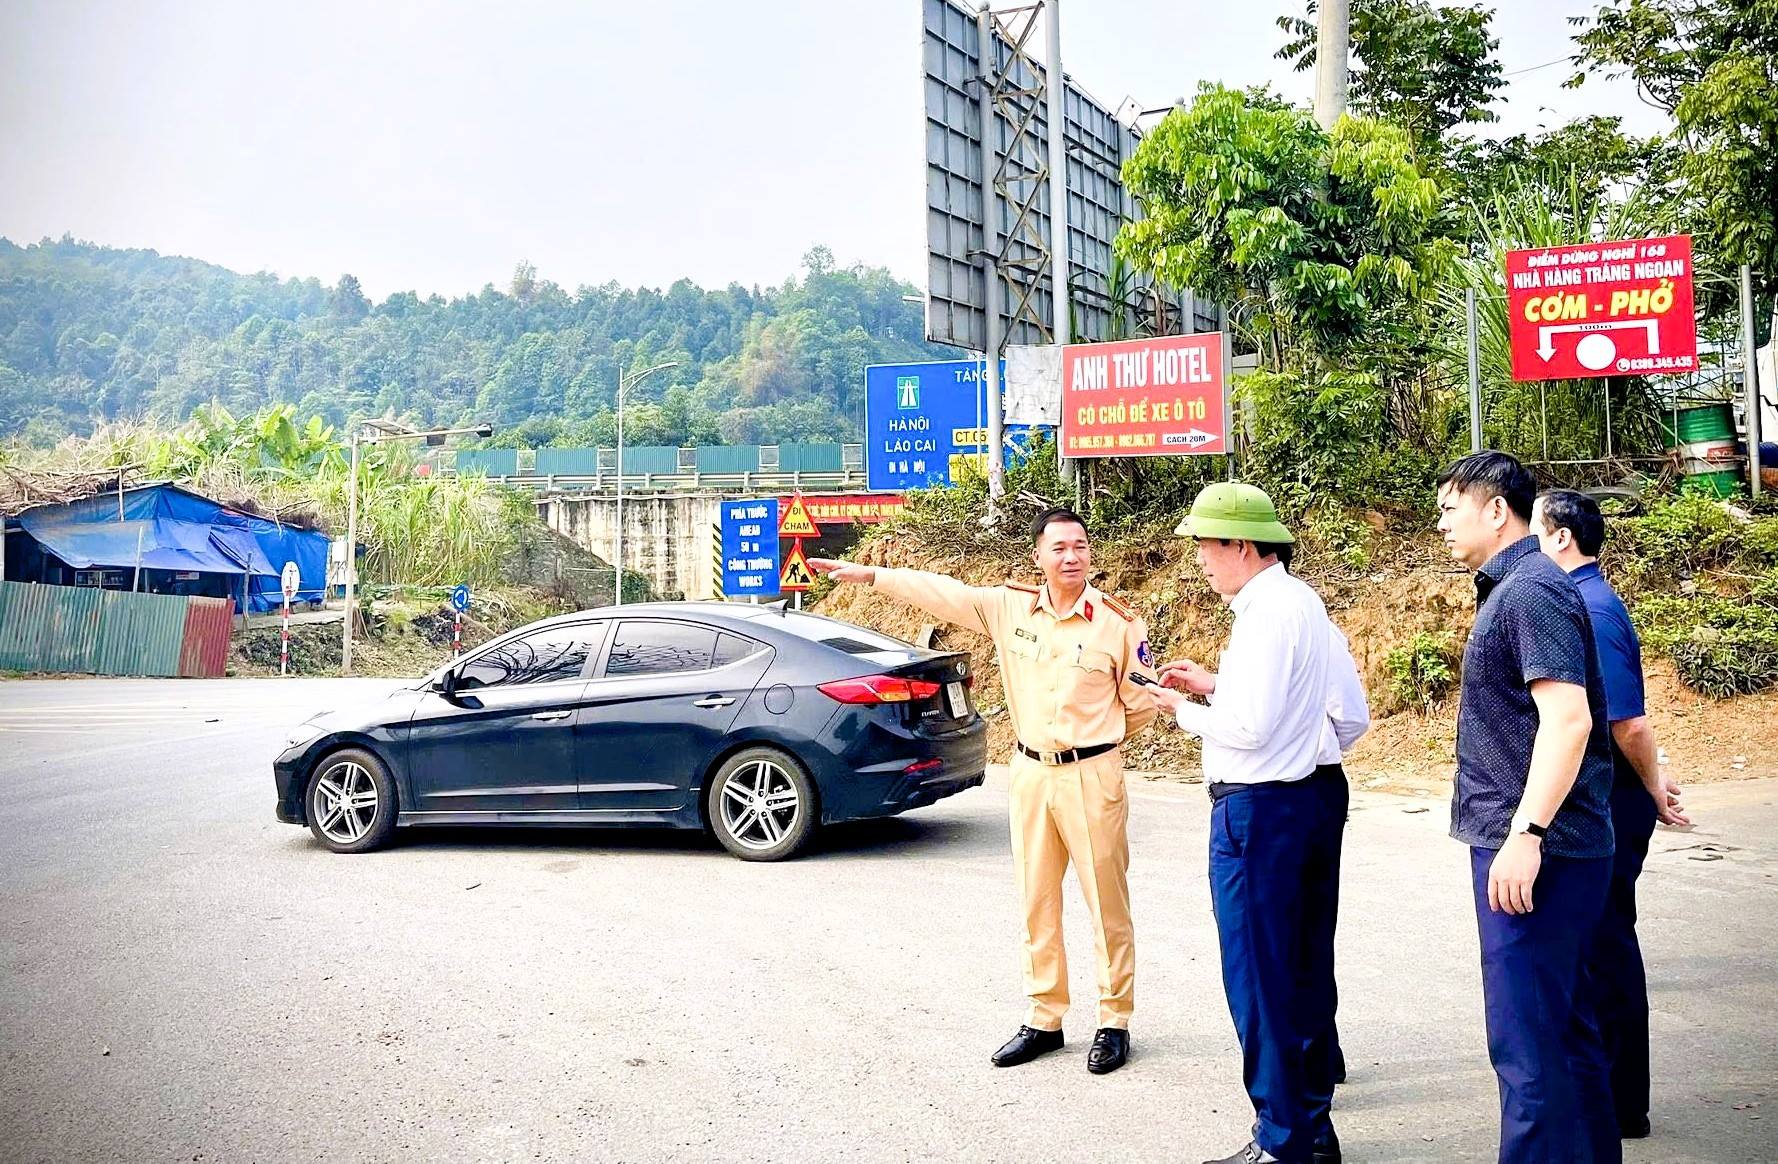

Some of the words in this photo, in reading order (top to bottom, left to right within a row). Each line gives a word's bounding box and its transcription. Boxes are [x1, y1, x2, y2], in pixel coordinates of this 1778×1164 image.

[1640, 244, 1666, 258] 168
[1513, 268, 1541, 289] NHÀ
[1544, 266, 1582, 287] HÀNG
[1634, 259, 1684, 280] NGOAN
[1524, 290, 1587, 323] CƠM
[1610, 278, 1675, 317] PHỞ
[1072, 355, 1108, 392] ANH
[1112, 348, 1150, 389] THƯ
[1152, 347, 1212, 386] HOTEL
[1078, 404, 1096, 426] CÓ
[1099, 398, 1126, 425] CHỖ
[1130, 396, 1148, 423] ĐỂ
[1152, 402, 1170, 422] XE
[1174, 397, 1184, 421] Ô
[1187, 397, 1206, 421] TÔ
[885, 438, 911, 453] LÀO
[915, 439, 936, 452] CAI
[1189, 435, 1206, 443] 20M
[792, 507, 801, 516] ĐI
